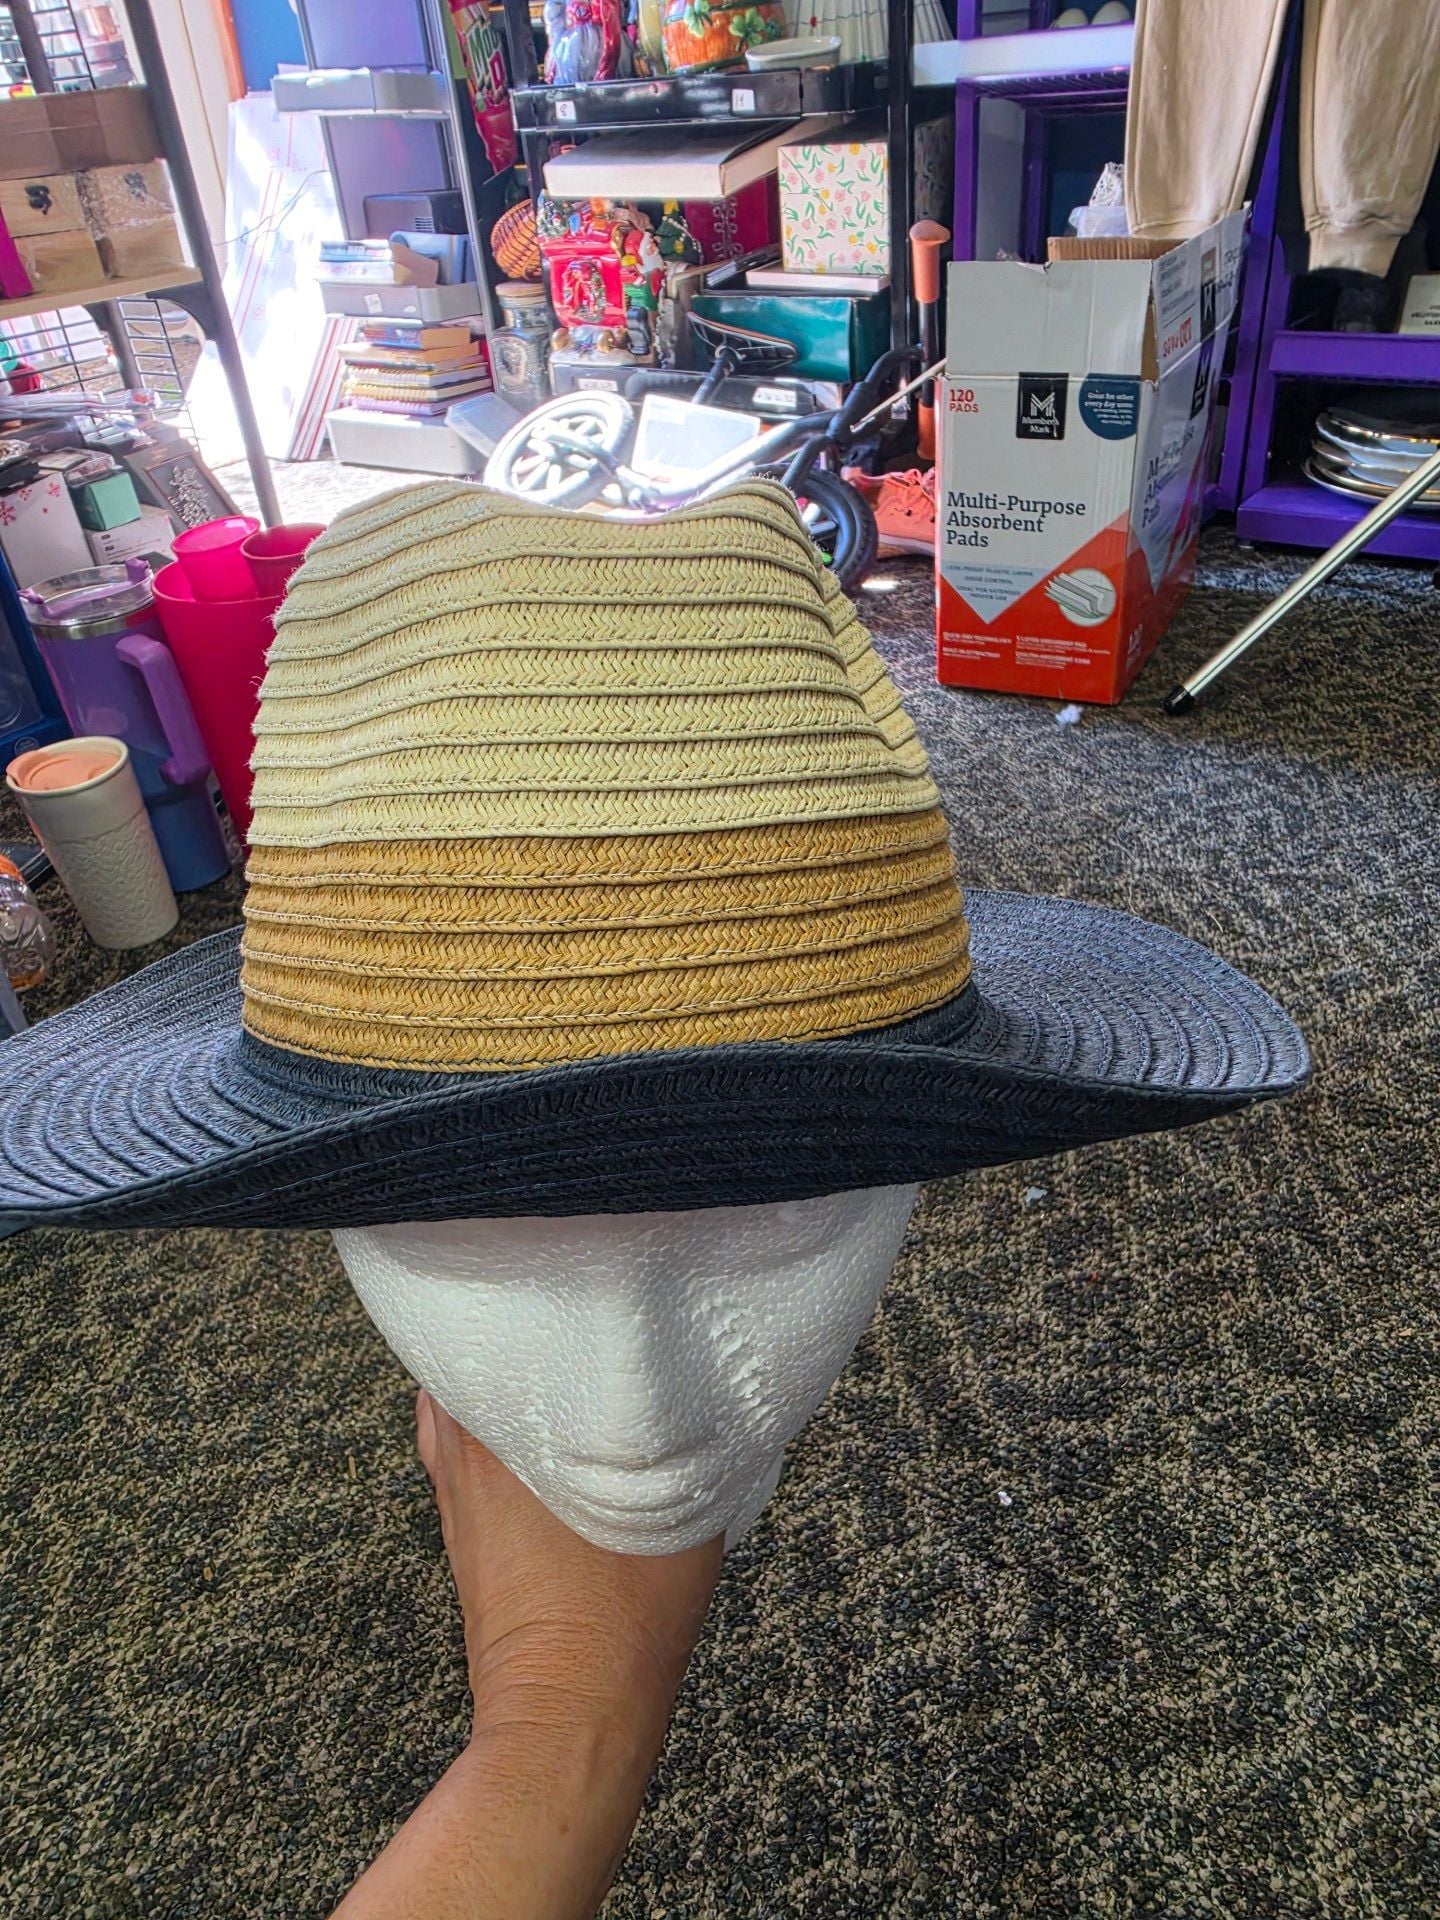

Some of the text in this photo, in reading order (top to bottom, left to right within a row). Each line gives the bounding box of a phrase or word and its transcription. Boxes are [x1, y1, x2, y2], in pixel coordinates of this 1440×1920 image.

[950, 389, 975, 402] 120
[949, 403, 979, 414] PADS
[947, 491, 1086, 518] Multi-Purpose
[946, 510, 1044, 533] Absorbent
[946, 529, 989, 548] Pads
